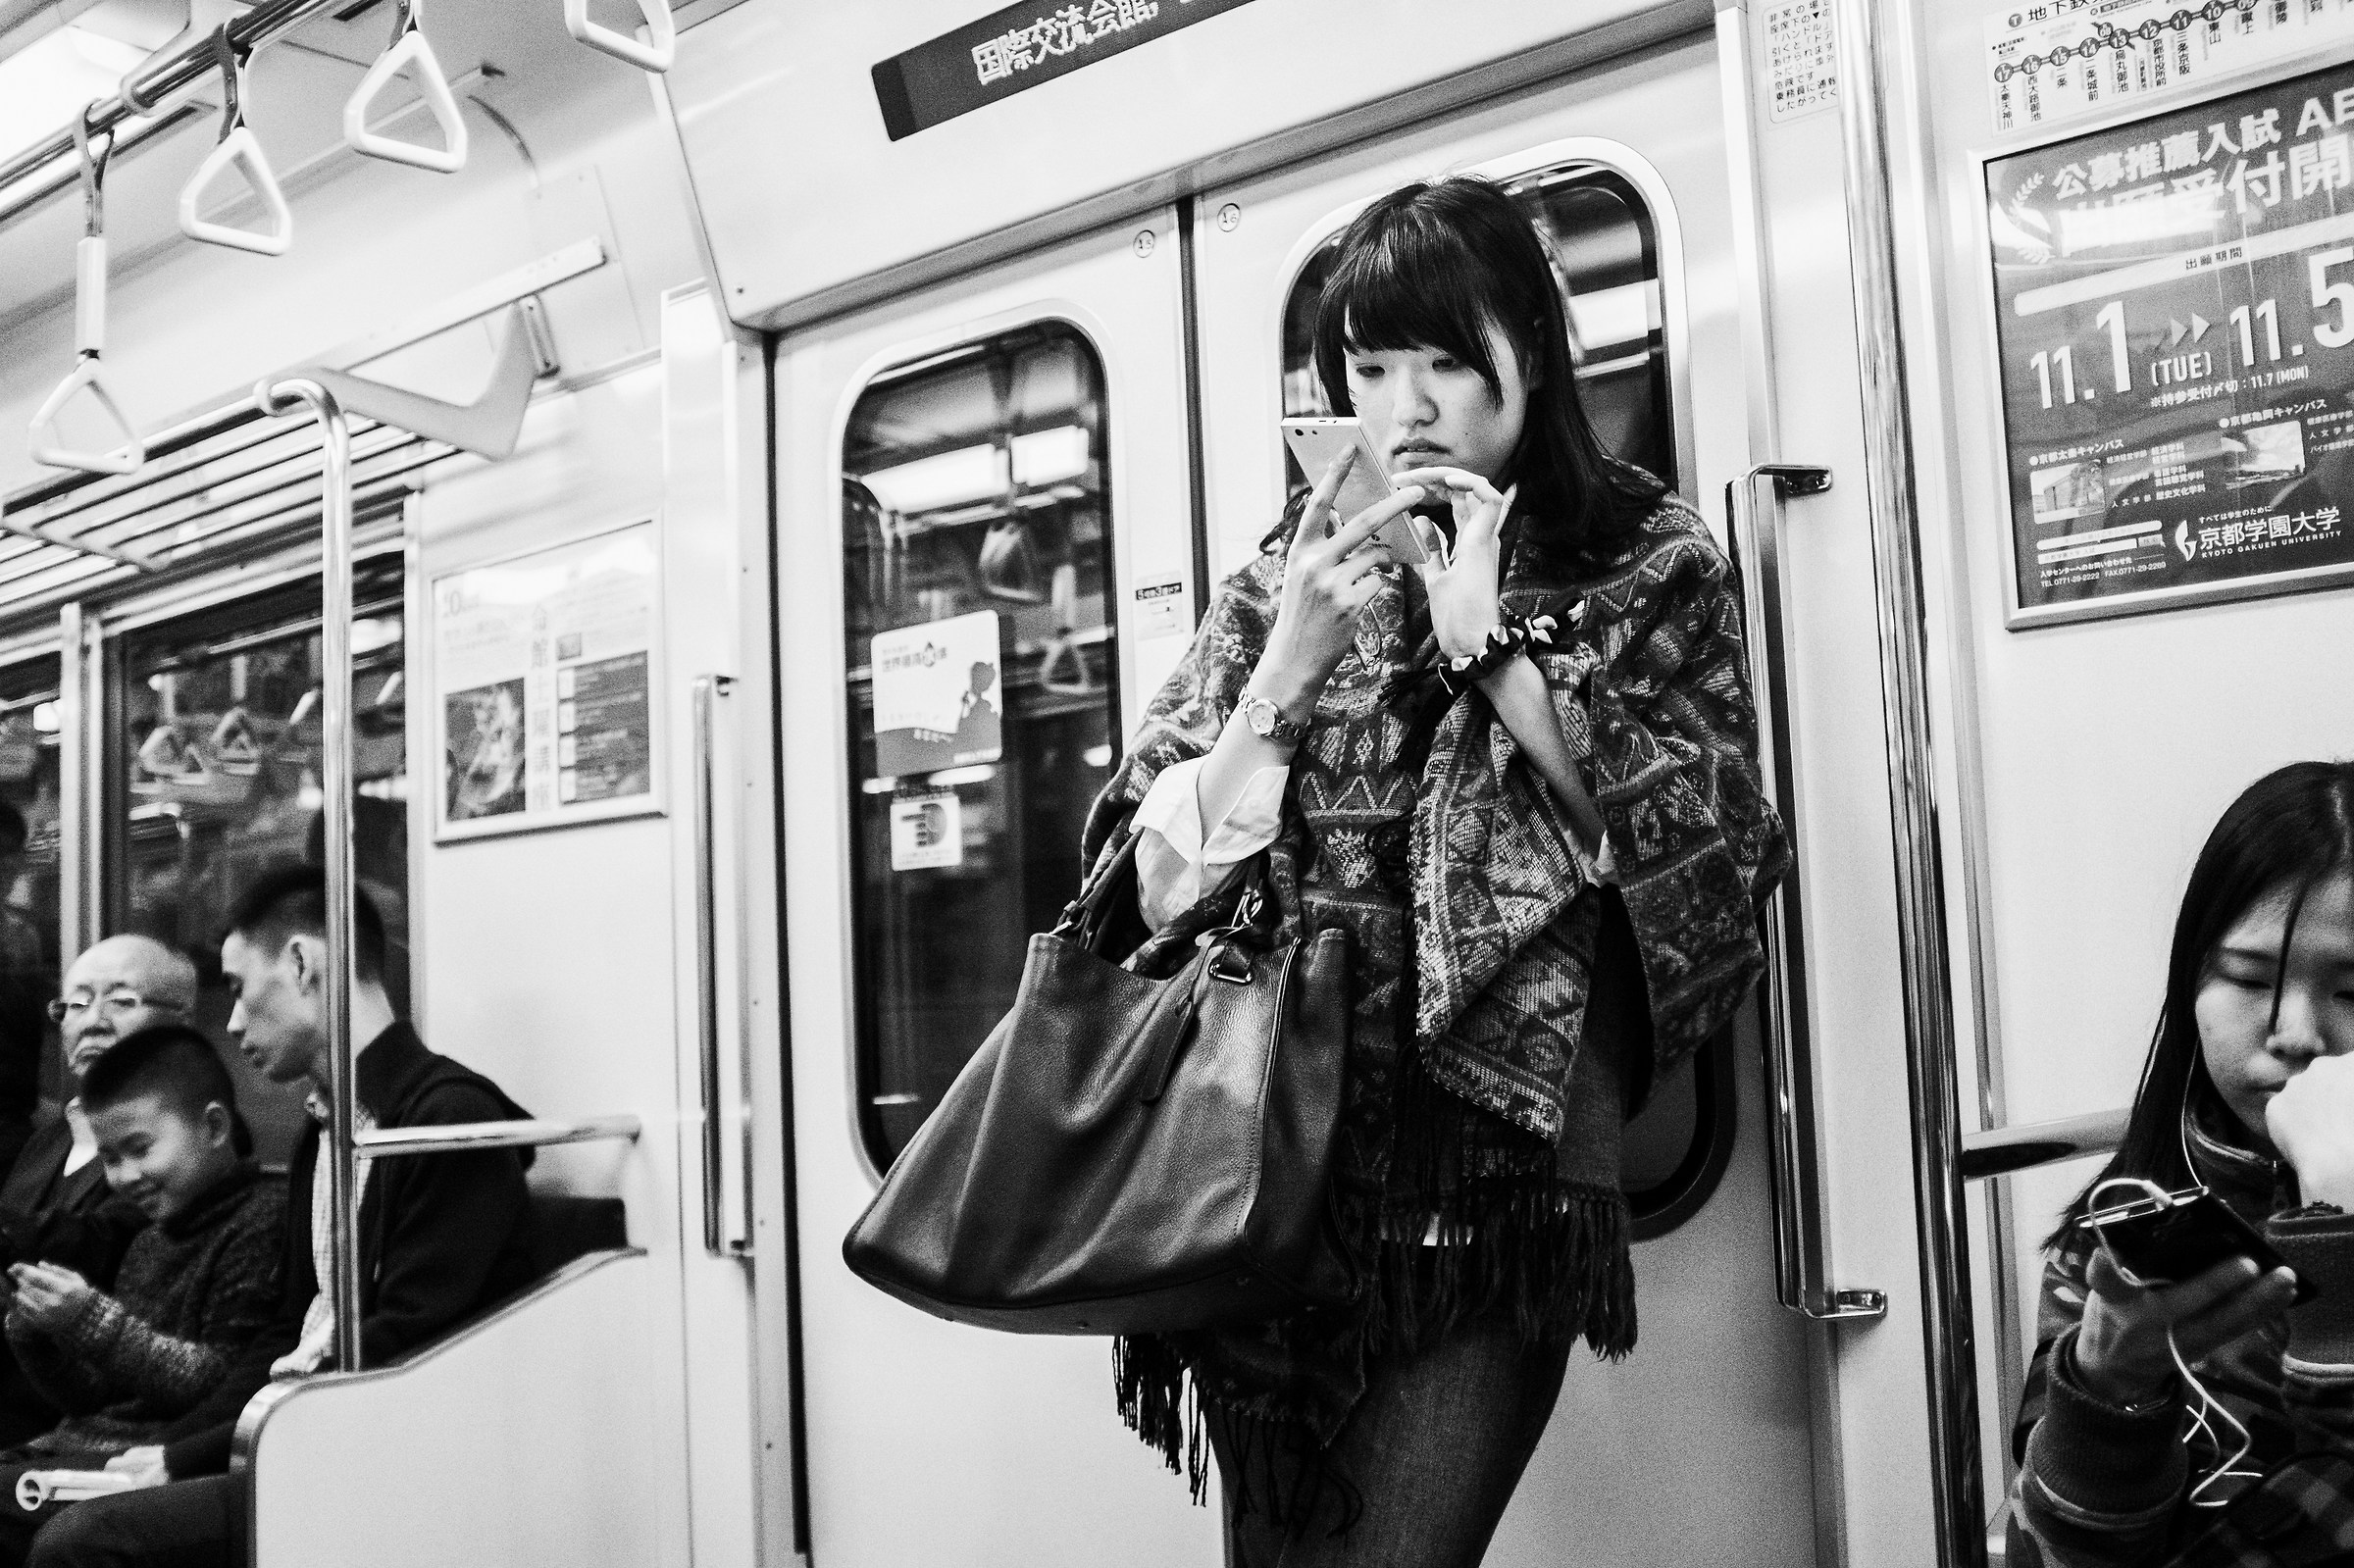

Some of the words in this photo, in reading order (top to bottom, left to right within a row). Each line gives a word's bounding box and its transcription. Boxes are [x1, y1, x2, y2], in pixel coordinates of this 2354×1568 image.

[2177, 30, 2190, 76] 三条京阪
[2057, 68, 2068, 88] 二条
[2085, 59, 2098, 101] 二条城前
[2052, 108, 2281, 201] 公募推薦入試
[2185, 247, 2243, 270] 出願期間
[2199, 506, 2273, 524] すべては学生のために
[2199, 506, 2341, 550] 京都学園大学
[2202, 548, 2233, 559] KYOTO
[2238, 540, 2277, 553] GAKUEN
[2281, 530, 2342, 545] UNIVERSITY
